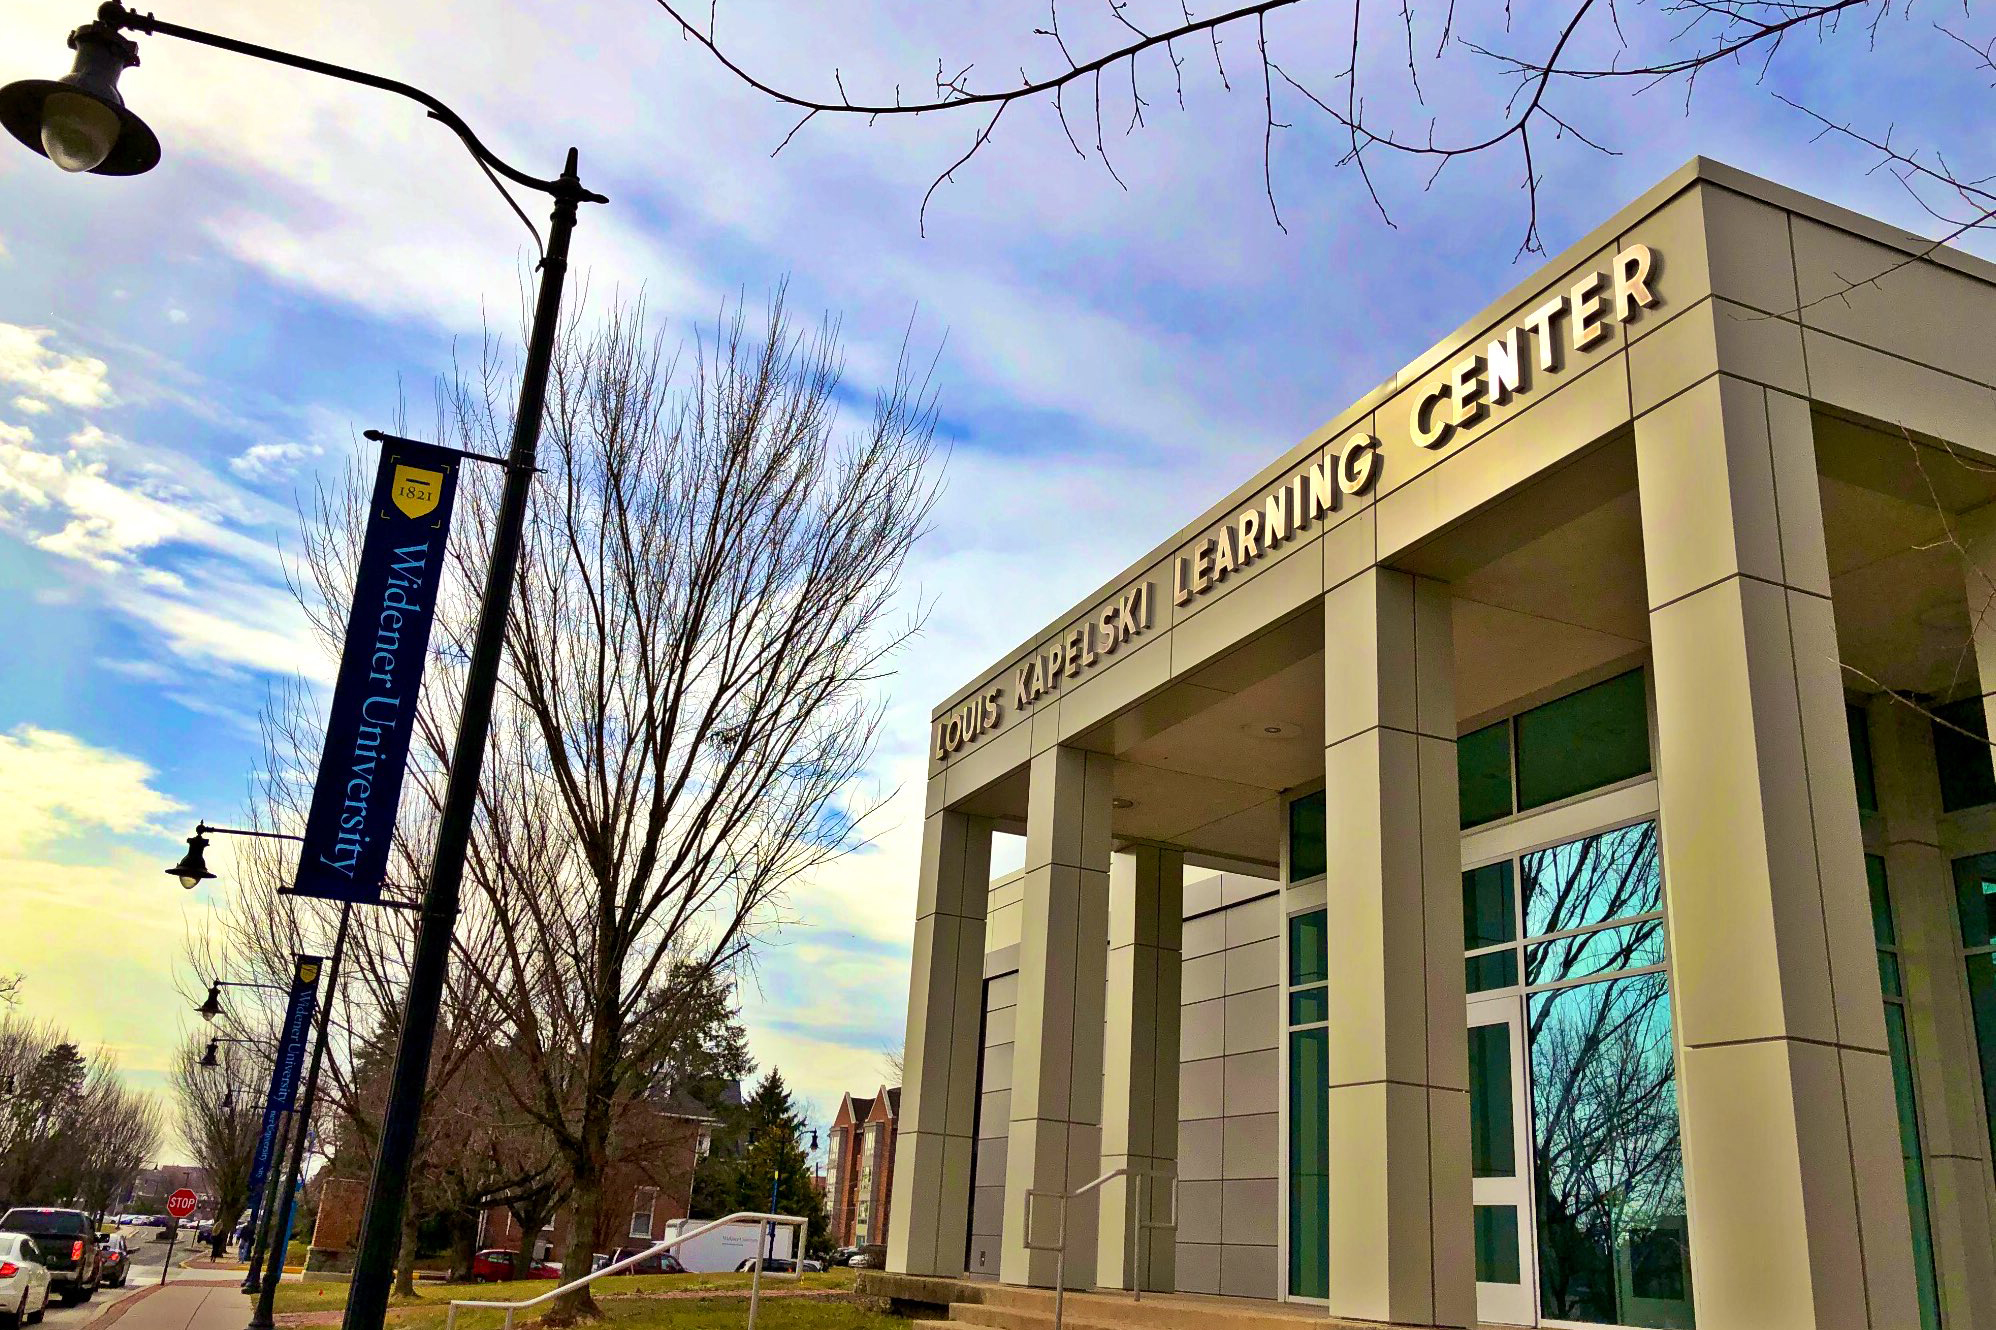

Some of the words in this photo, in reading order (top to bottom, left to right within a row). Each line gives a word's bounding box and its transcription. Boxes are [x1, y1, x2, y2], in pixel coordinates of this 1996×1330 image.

[399, 486, 433, 502] 1821
[935, 687, 1003, 761] LOUIS
[1014, 581, 1152, 711] KAPELSKI
[1174, 432, 1382, 607] LEARNING
[1409, 243, 1661, 450] CENTER
[368, 541, 429, 688] Widener
[320, 695, 400, 879] University
[290, 990, 312, 1042] Widener
[273, 1043, 301, 1103] University
[170, 1197, 195, 1208] STOP
